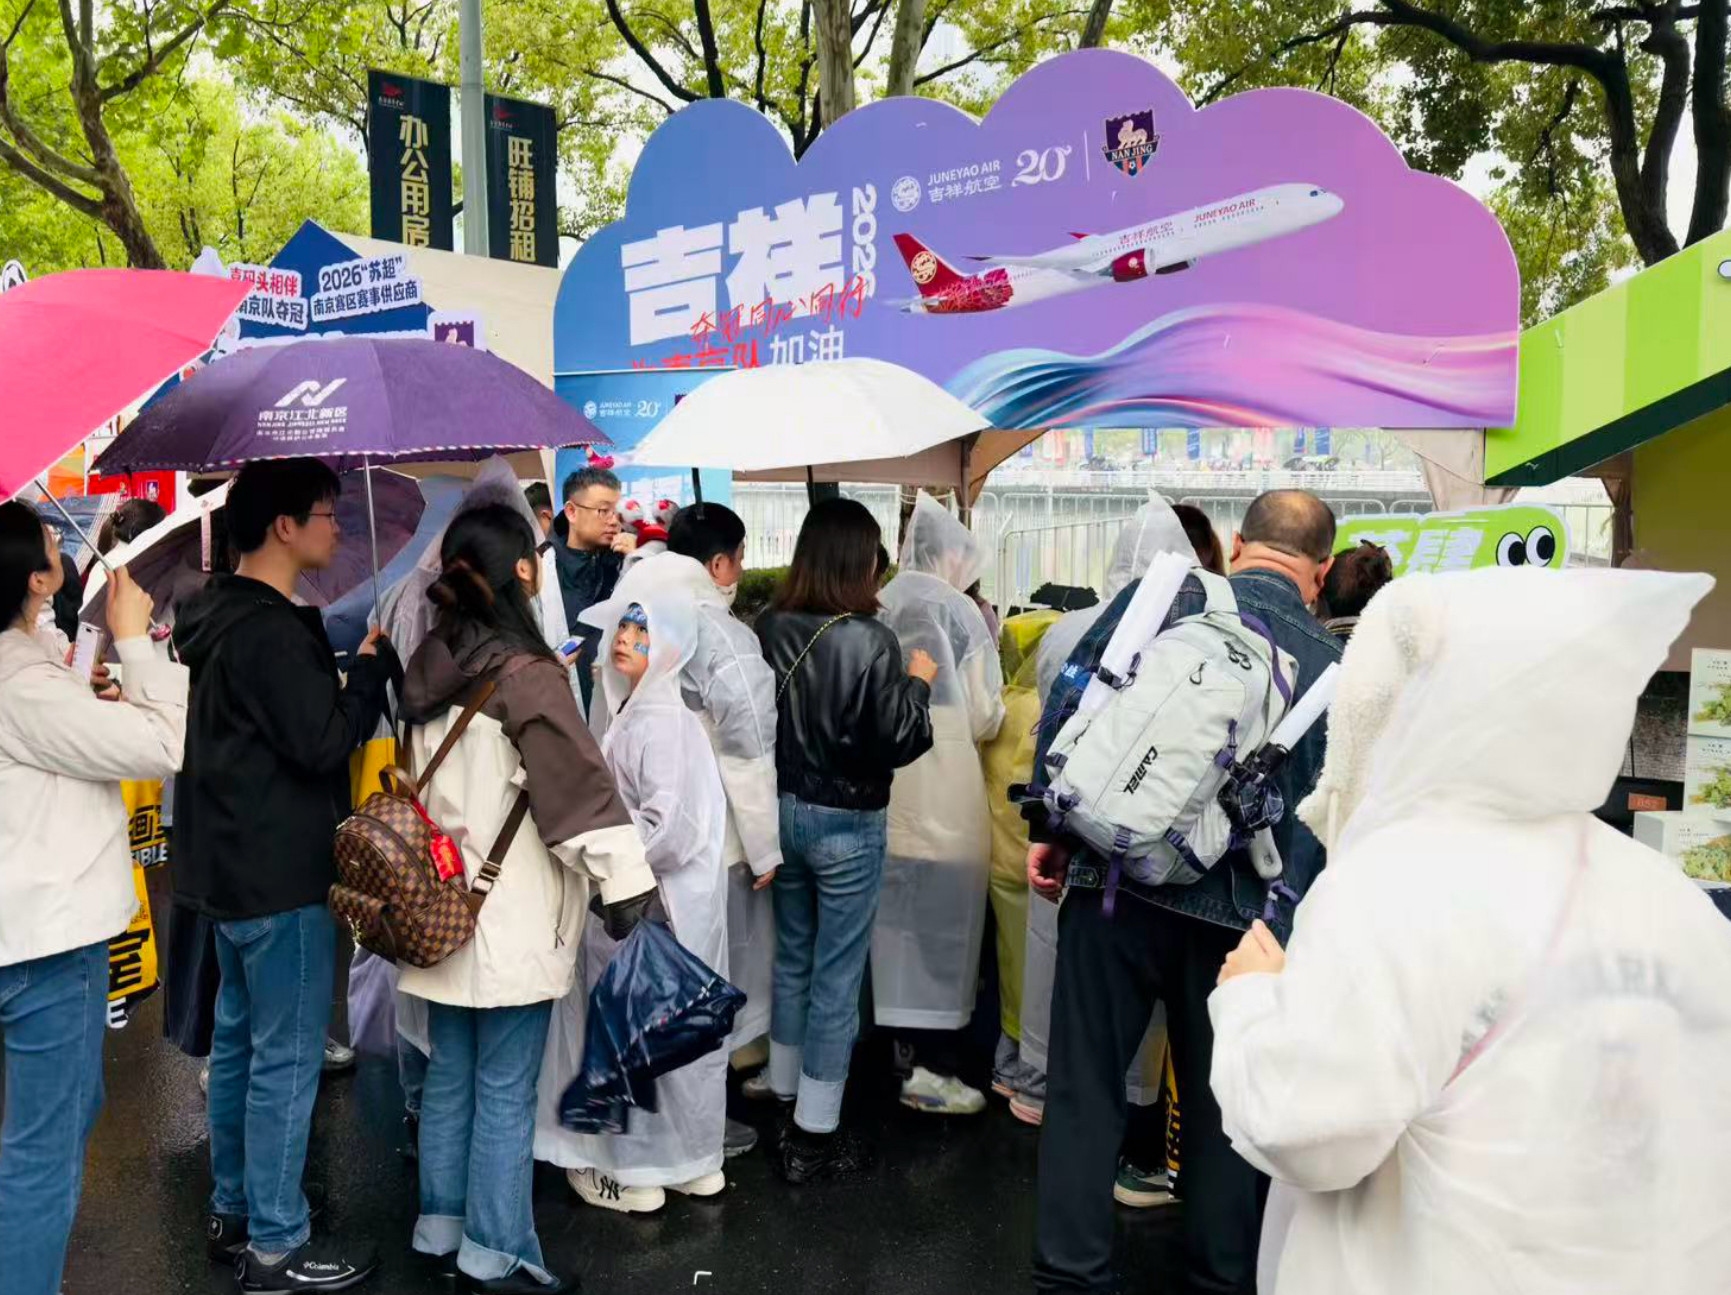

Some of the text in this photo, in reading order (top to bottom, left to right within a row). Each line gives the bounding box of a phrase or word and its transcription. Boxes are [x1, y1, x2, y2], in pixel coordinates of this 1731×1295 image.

[1111, 144, 1153, 161] NANJING
[927, 175, 1001, 202] 吉祥航空
[928, 160, 1001, 187] JUNEYAO AIR
[507, 135, 536, 263] 旺铺招租
[1194, 198, 1256, 223] JUNEYAO AIR
[852, 184, 878, 298] 2026
[621, 192, 844, 346] 吉祥
[313, 279, 418, 316] 南京赛区赛事供应商
[769, 324, 844, 366] 加油
[259, 407, 348, 421] 南京江北新区
